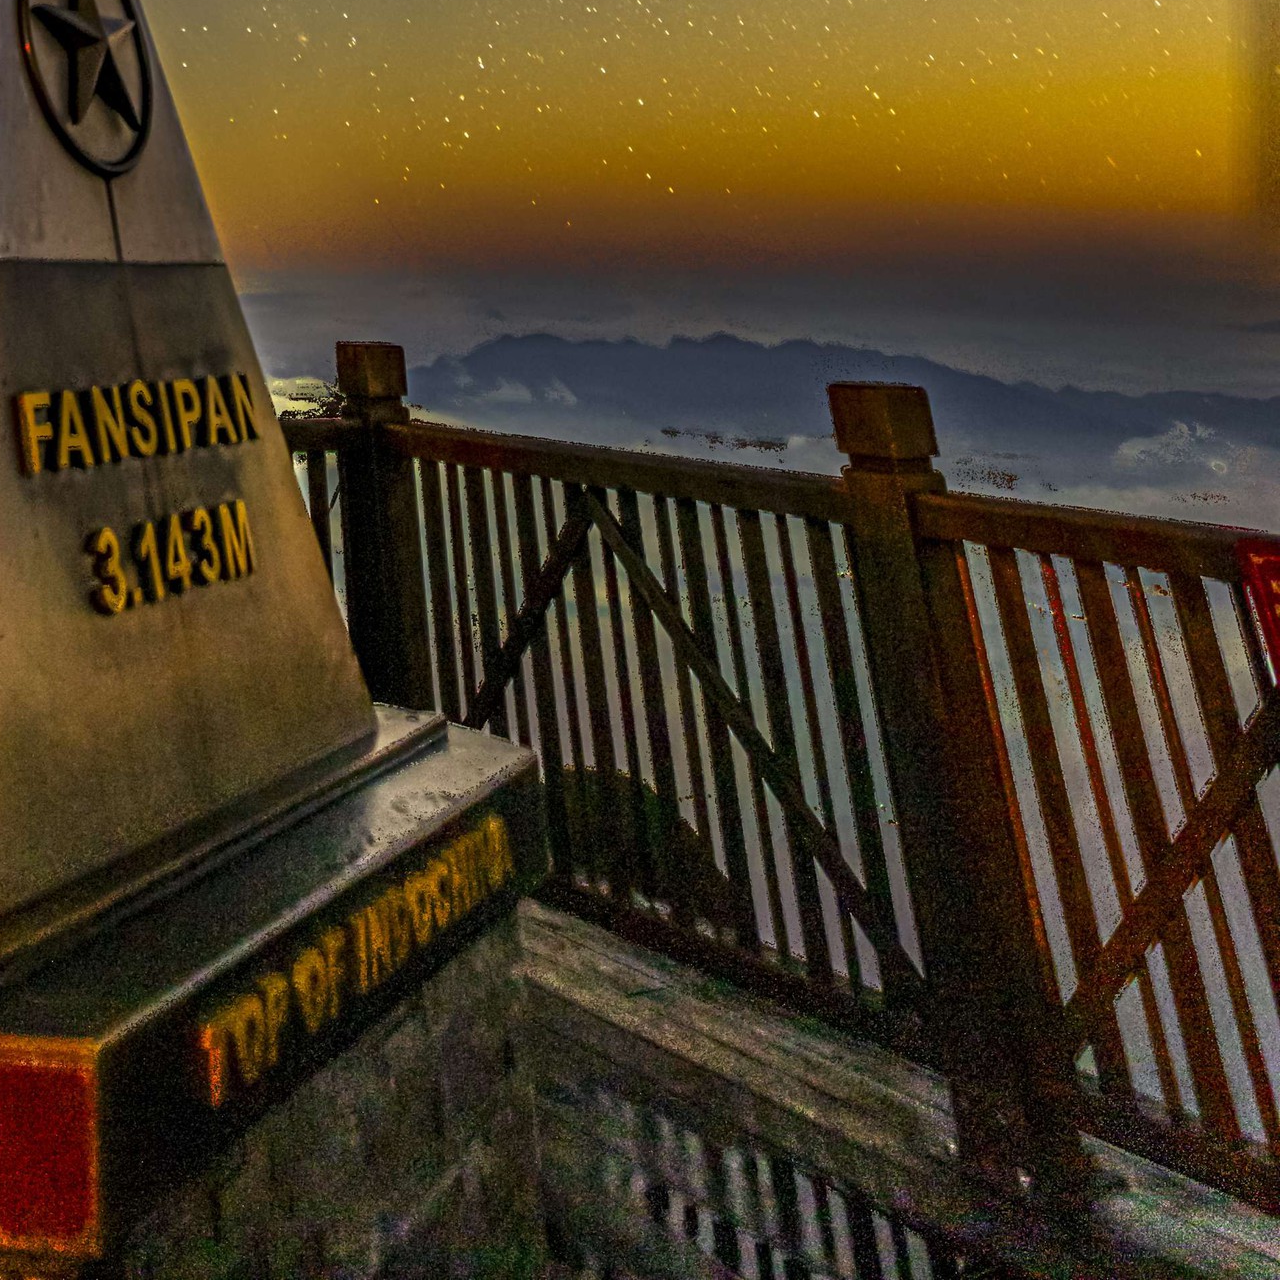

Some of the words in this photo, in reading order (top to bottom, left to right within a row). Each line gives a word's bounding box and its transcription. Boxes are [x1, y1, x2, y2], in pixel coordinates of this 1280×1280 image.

[17, 371, 261, 475] FANSIPAN
[95, 498, 256, 614] 3.143M
[197, 972, 290, 1109] TOP
[292, 927, 346, 1035] OF
